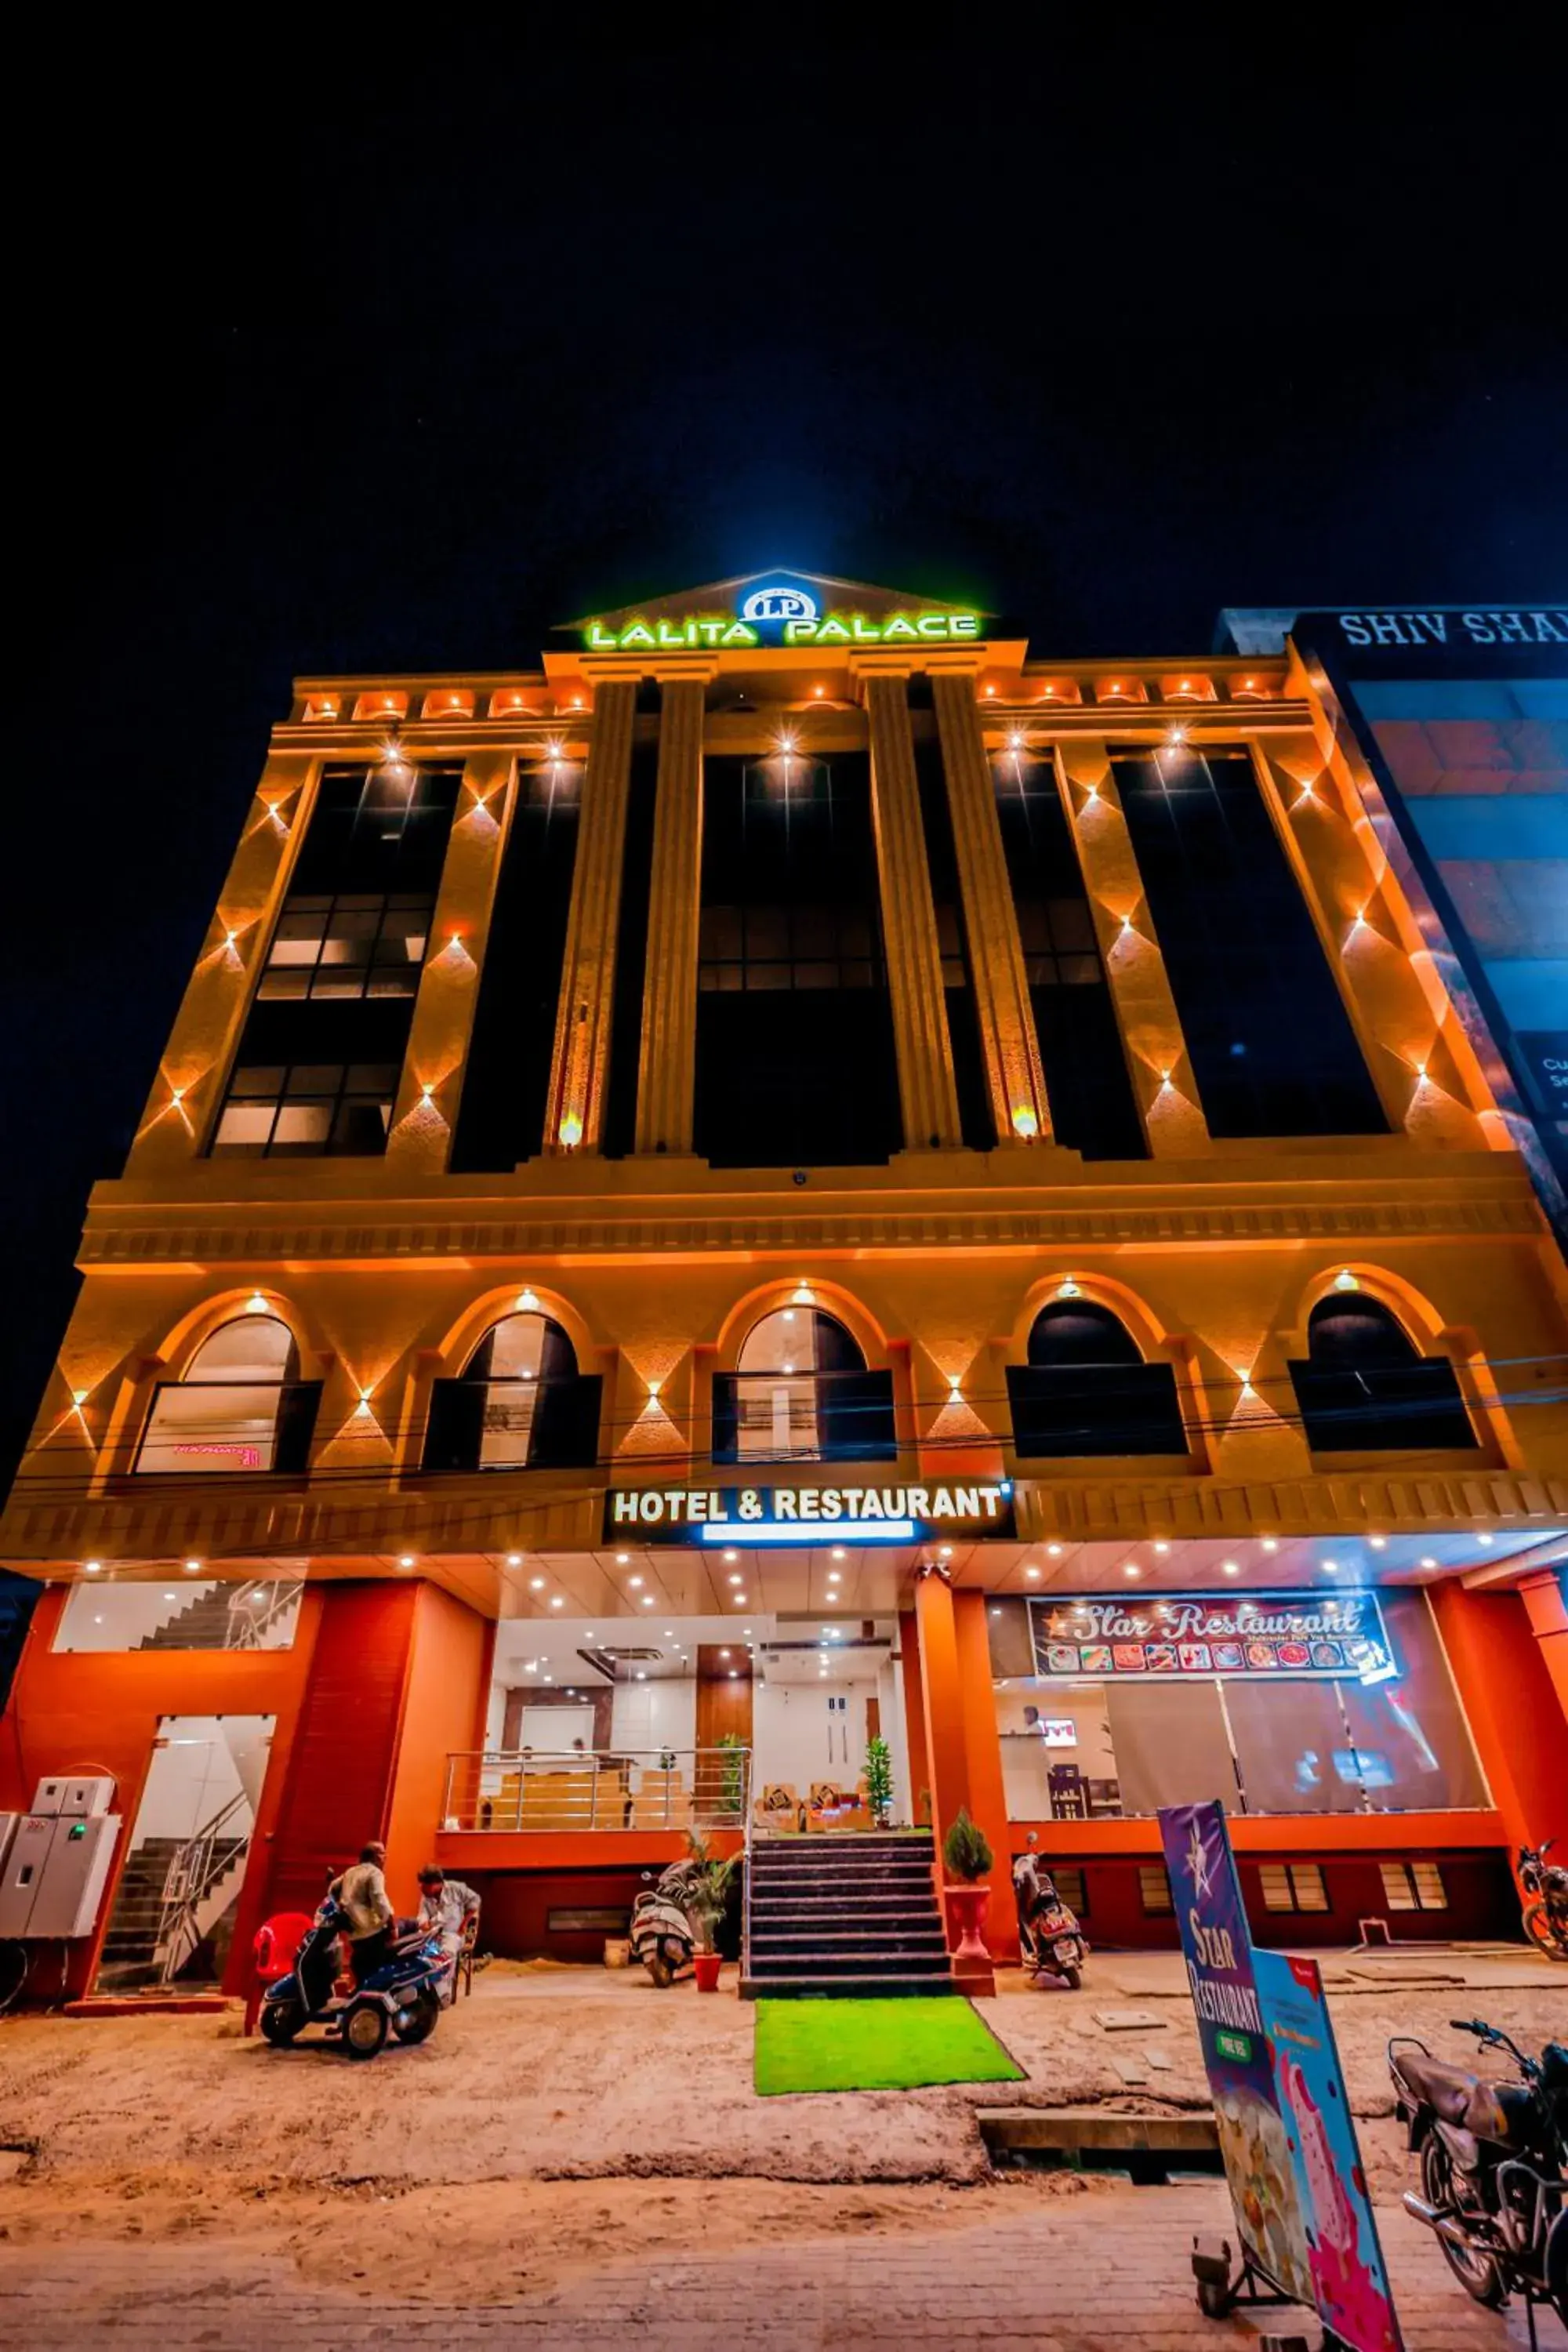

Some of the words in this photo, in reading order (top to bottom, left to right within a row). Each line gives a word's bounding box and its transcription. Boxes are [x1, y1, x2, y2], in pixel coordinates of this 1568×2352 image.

[762, 598, 800, 617] LP
[591, 621, 758, 646] LALITA
[787, 615, 978, 639] PALACE
[1339, 614, 1447, 644] SHIV
[614, 1491, 728, 1522] HOTEL
[738, 1490, 764, 1519] &
[774, 1486, 1002, 1519] RESTAURANT
[1073, 1604, 1155, 1640] Star
[1161, 1602, 1363, 1639] Restaurant
[1189, 1907, 1238, 1970] STAR
[1186, 1958, 1262, 2034] RESTAURANT
